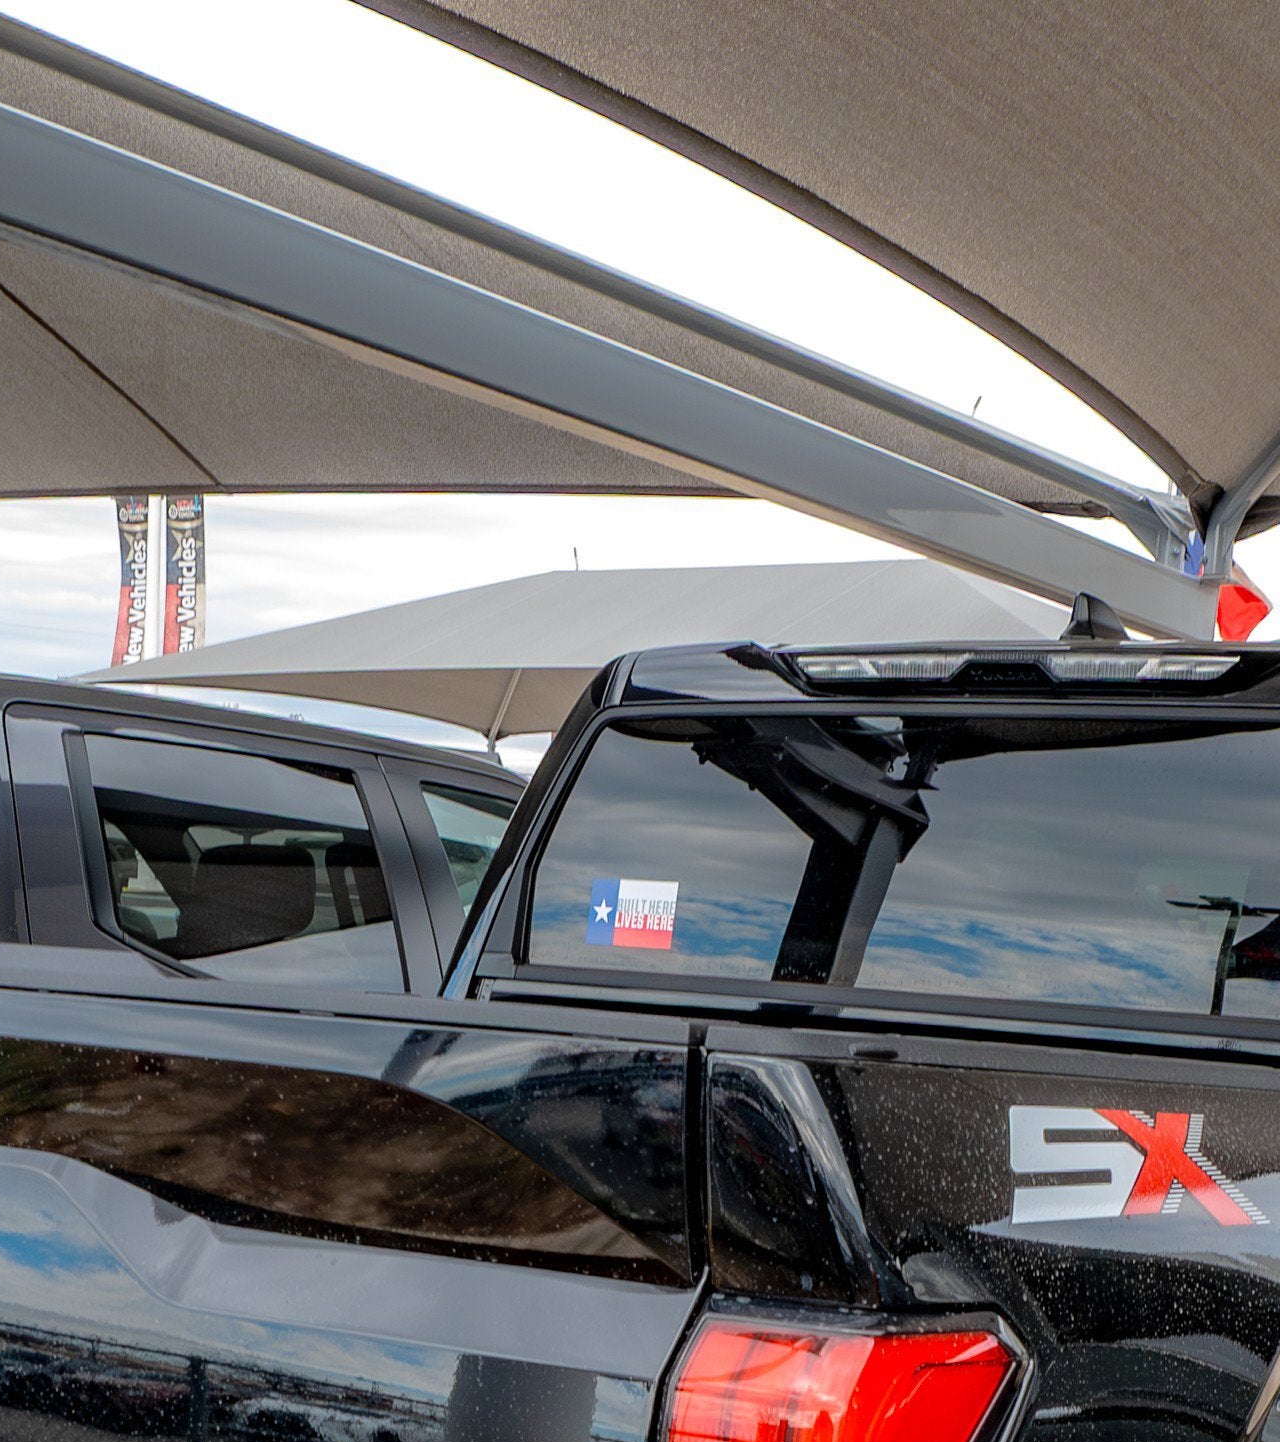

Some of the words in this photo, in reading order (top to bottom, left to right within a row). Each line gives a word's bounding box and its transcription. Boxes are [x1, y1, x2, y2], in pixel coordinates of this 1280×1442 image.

[129, 539, 147, 623] Vehicles
[177, 537, 196, 622] Vehicles
[179, 626, 196, 655] ew
[614, 911, 645, 929] LIVES
[646, 913, 674, 931] HERE
[617, 898, 647, 914] BUILT
[648, 899, 677, 915] HERE
